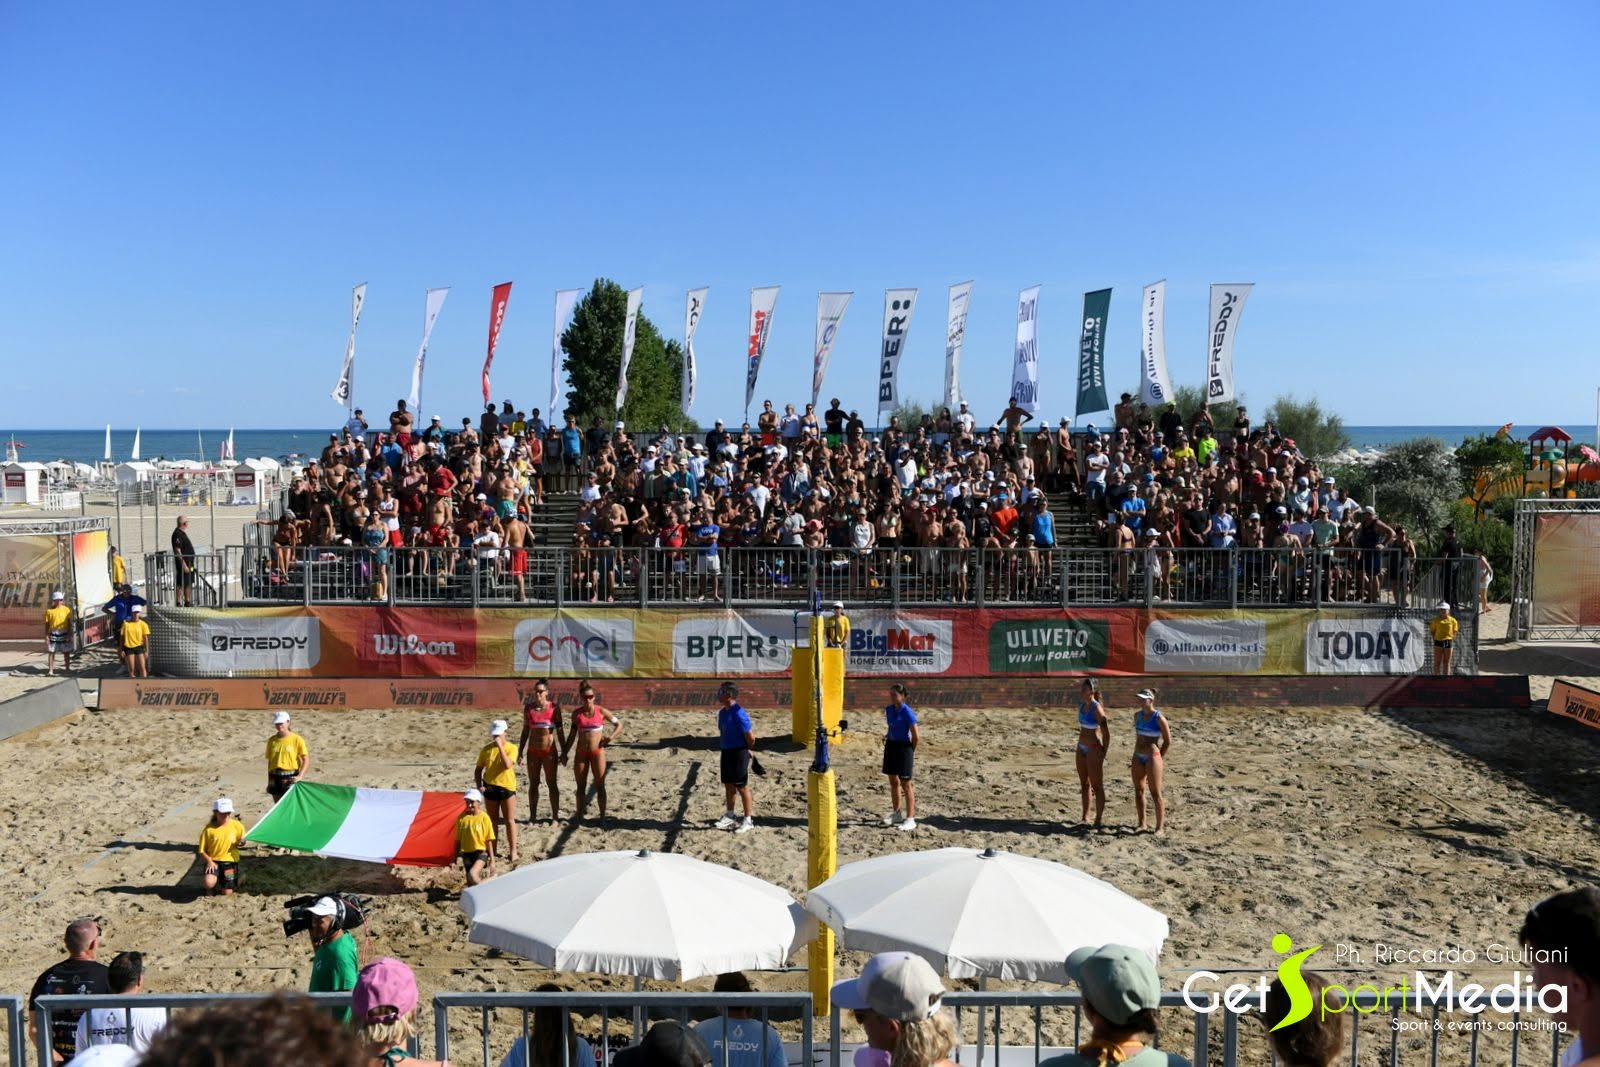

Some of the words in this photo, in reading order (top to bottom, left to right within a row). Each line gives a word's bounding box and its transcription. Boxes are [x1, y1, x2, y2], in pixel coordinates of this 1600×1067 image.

[1210, 291, 1238, 378] FREDDY
[1081, 317, 1095, 392] ULIVETO
[1093, 366, 1102, 388] VIVI
[229, 636, 308, 650] FREDDY
[373, 633, 457, 656] Wilson
[528, 628, 620, 663] enel
[850, 628, 936, 656] BigMat
[1006, 628, 1089, 649] ULIVETO
[1240, 643, 1258, 652] srl
[1317, 631, 1411, 660] TODAY
[1008, 654, 1032, 663] VIVI
[1035, 654, 1045, 662] IN
[1047, 650, 1087, 660] FORMA
[175, 692, 211, 705] VOLLEY
[302, 692, 339, 705] VOLLEY
